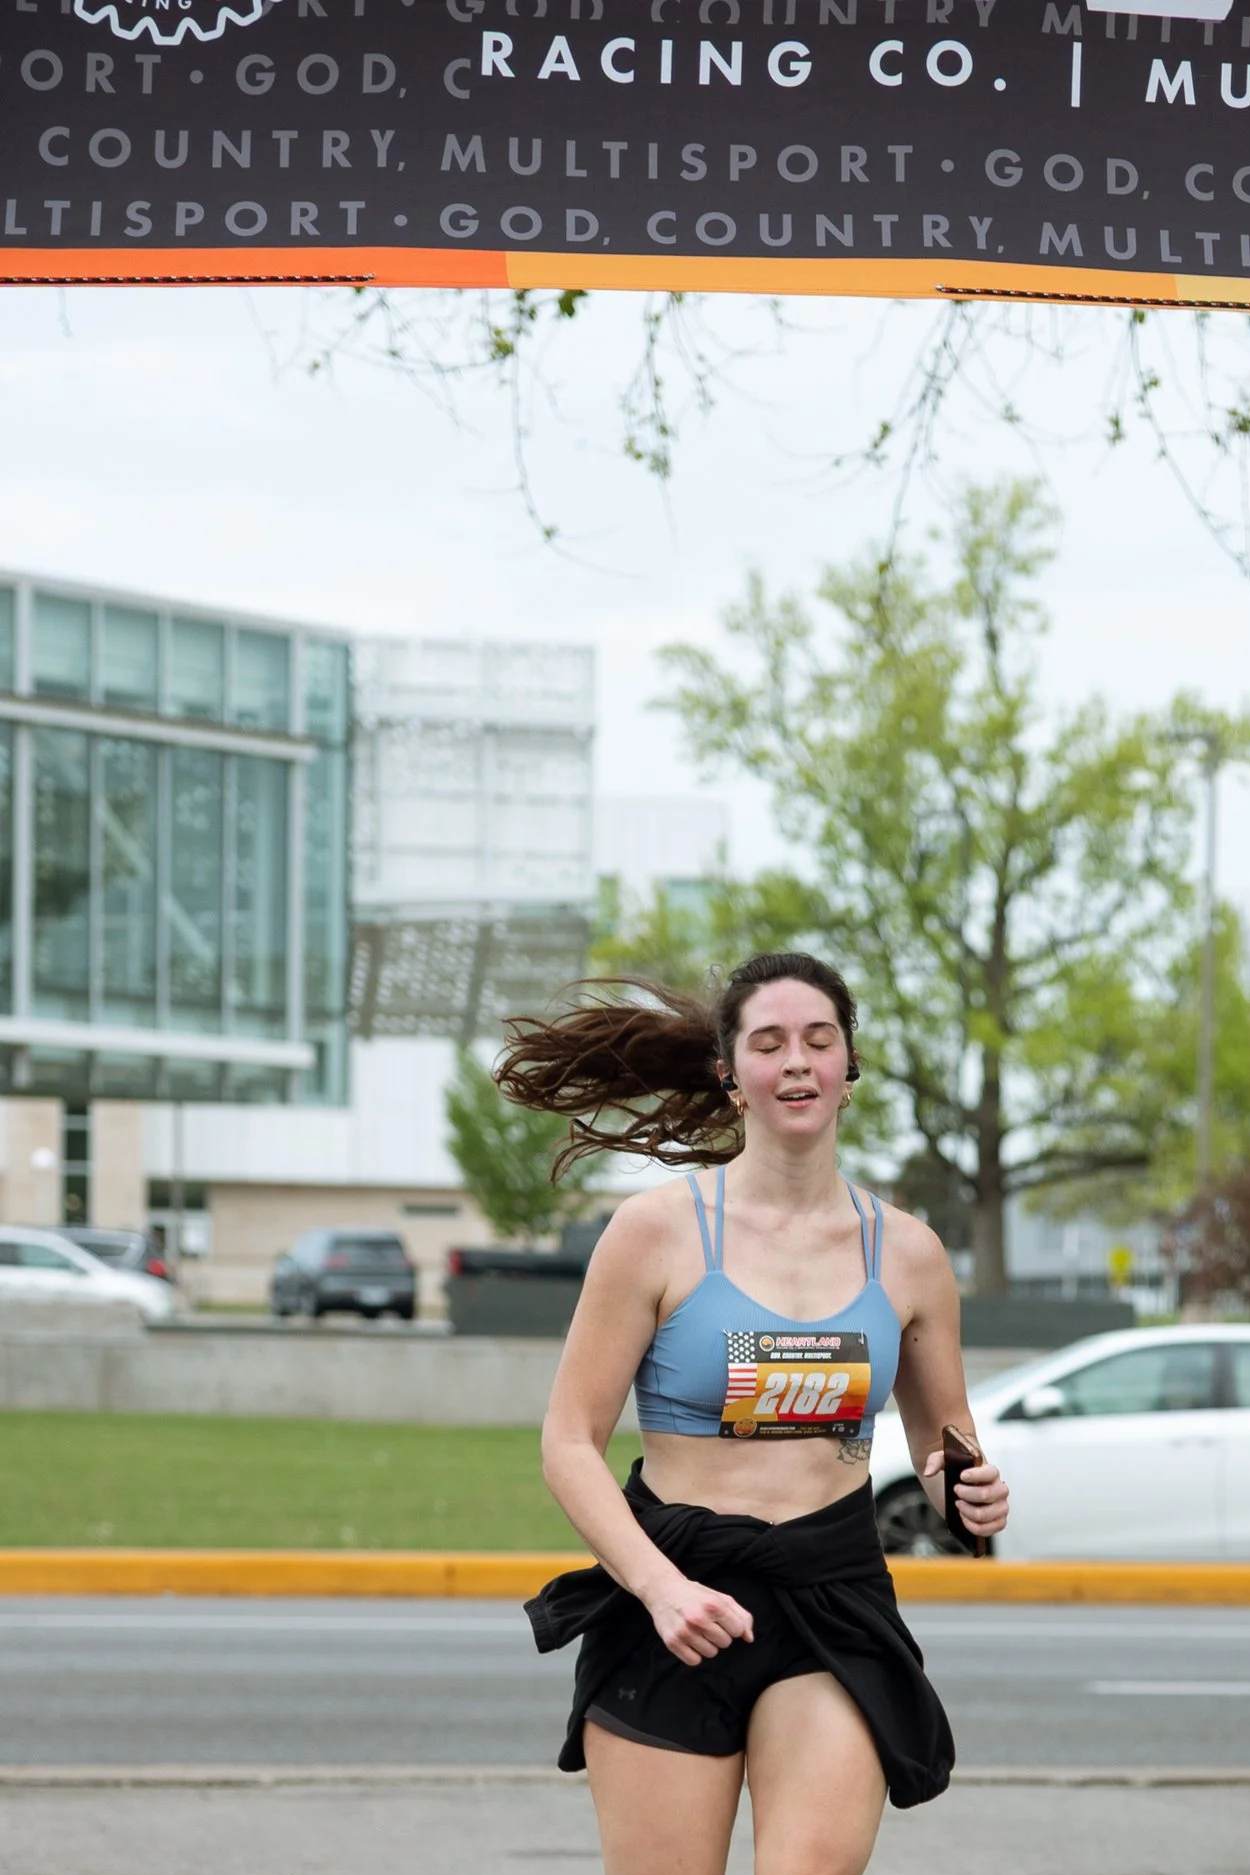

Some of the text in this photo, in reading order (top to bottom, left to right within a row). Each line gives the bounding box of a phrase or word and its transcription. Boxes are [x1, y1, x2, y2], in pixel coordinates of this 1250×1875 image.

[235, 53, 407, 99] GOD,
[480, 31, 813, 88] RACING
[868, 39, 1007, 91] CO.
[38, 126, 406, 172] COUNTRY,
[440, 134, 914, 183] MULTISPORT
[984, 148, 1151, 200] GOD,
[3, 199, 367, 238] LTISPORT
[439, 203, 611, 246] GOD,
[645, 210, 1004, 255] COUNTRY,
[776, 1336, 842, 1348] HEARTLAND
[754, 1373, 850, 1414] 2182
